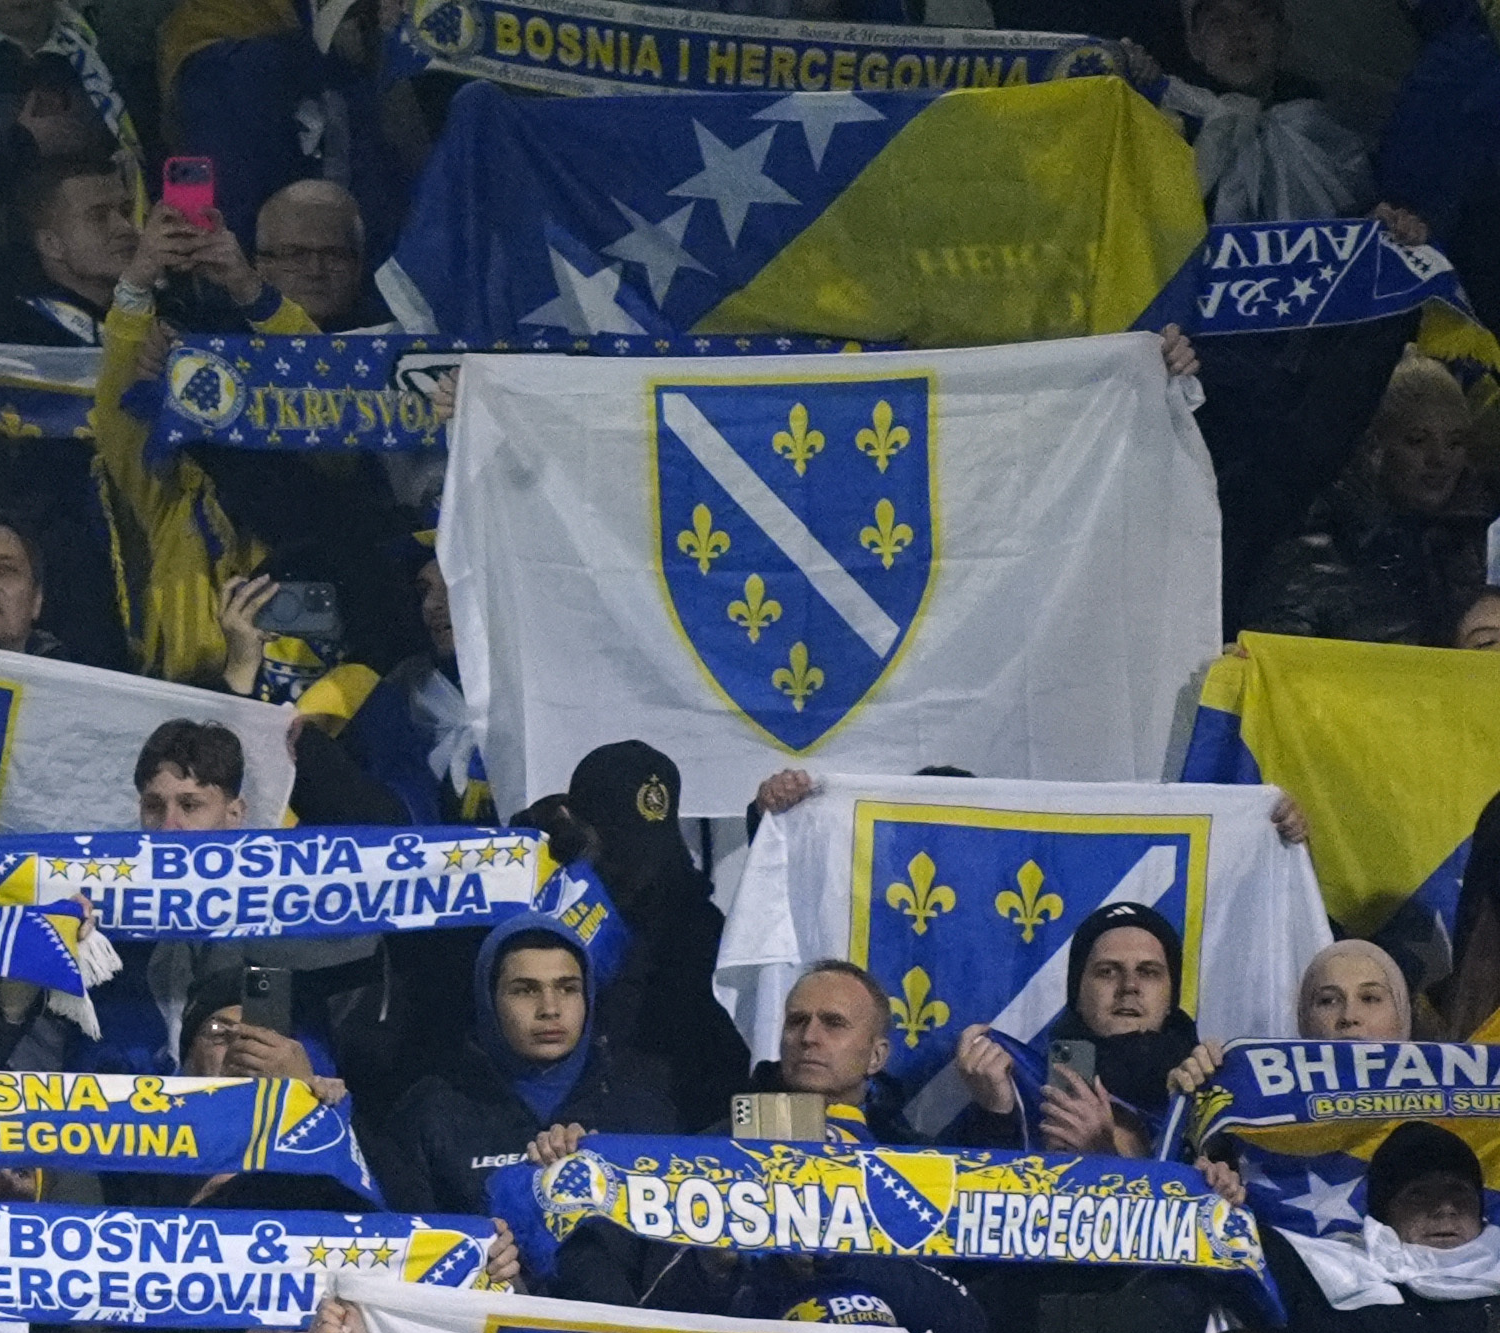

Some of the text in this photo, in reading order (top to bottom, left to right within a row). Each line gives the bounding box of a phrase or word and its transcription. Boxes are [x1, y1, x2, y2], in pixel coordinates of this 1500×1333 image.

[493, 17, 662, 78] BOSNIA
[706, 40, 1030, 91] HERCEGOVINA
[353, 391, 441, 436] SVOJ
[150, 836, 426, 880] BOSNA &
[90, 874, 489, 932] HERCEGOVINA
[135, 1075, 174, 1114] &
[1246, 1045, 1341, 1098] BH
[1313, 1092, 1443, 1116] BOSNIAN
[625, 1172, 873, 1252] BOSNA
[955, 1189, 1200, 1260] HERCEGOVINA
[7, 1214, 291, 1264] BOSNA &
